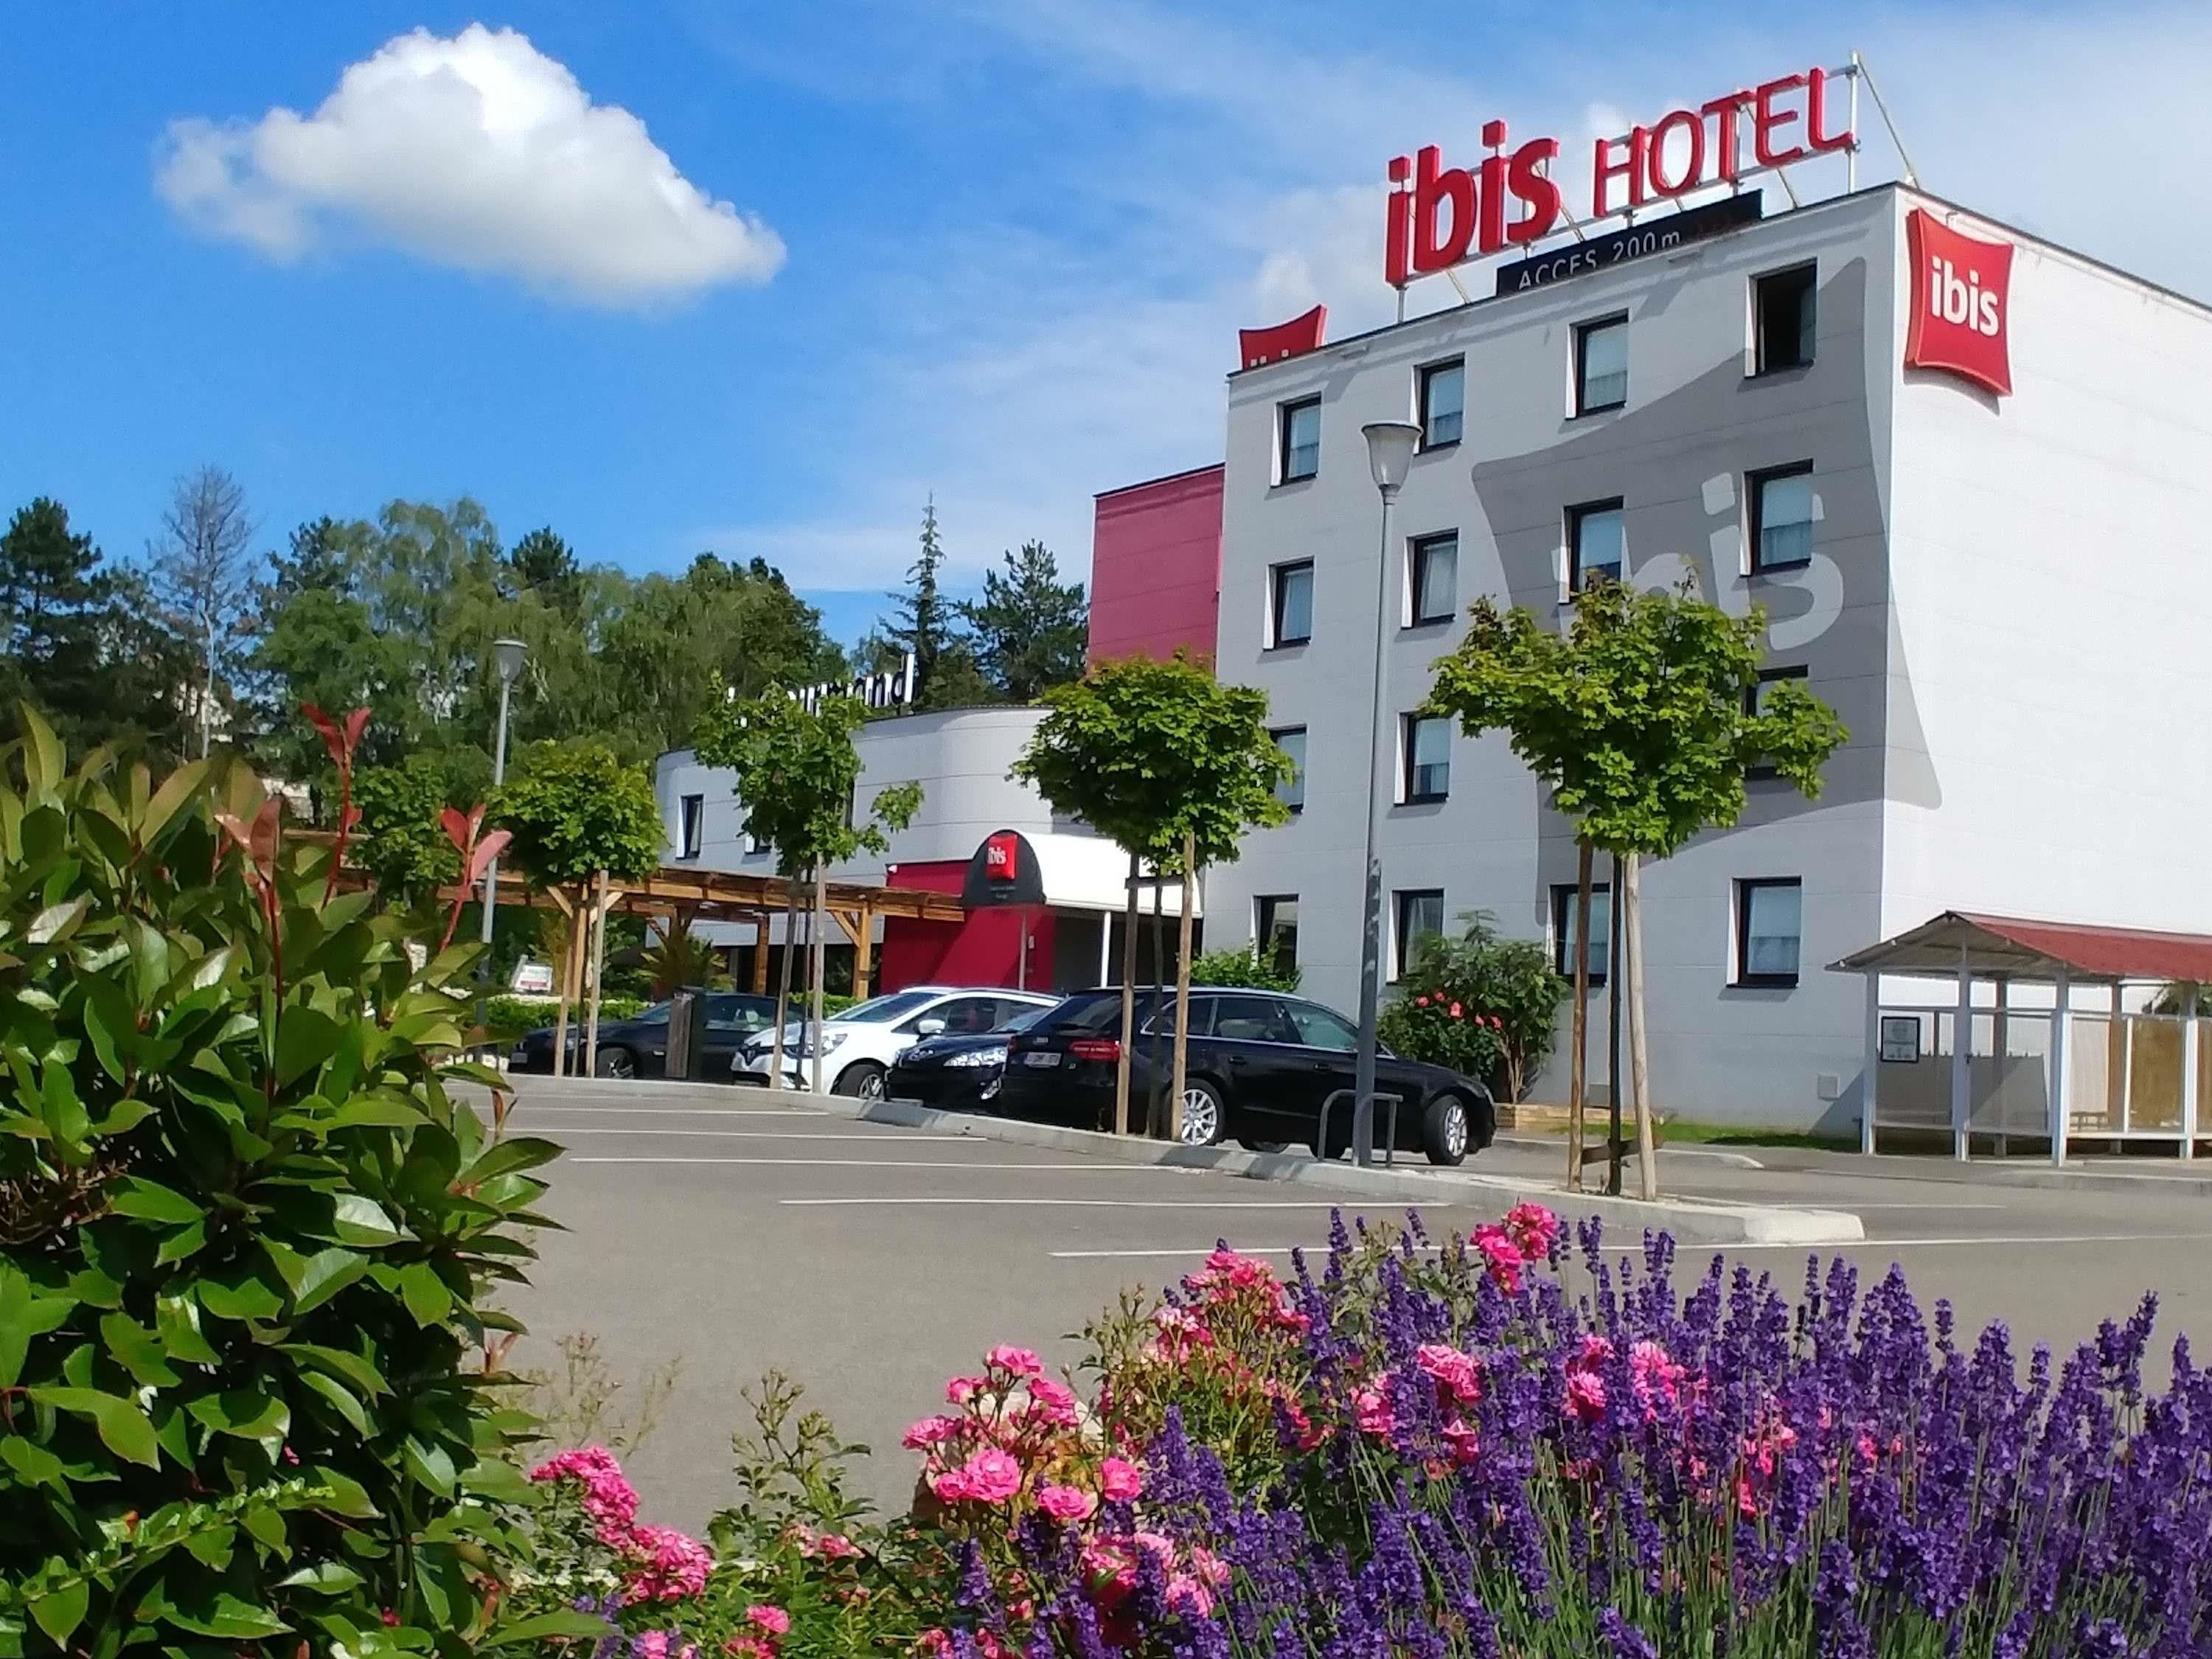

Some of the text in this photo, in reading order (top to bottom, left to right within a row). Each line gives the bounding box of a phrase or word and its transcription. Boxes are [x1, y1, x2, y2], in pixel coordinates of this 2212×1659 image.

[1385, 67, 1853, 286] ibis HOTEL
[1932, 255, 1999, 336] ibis
